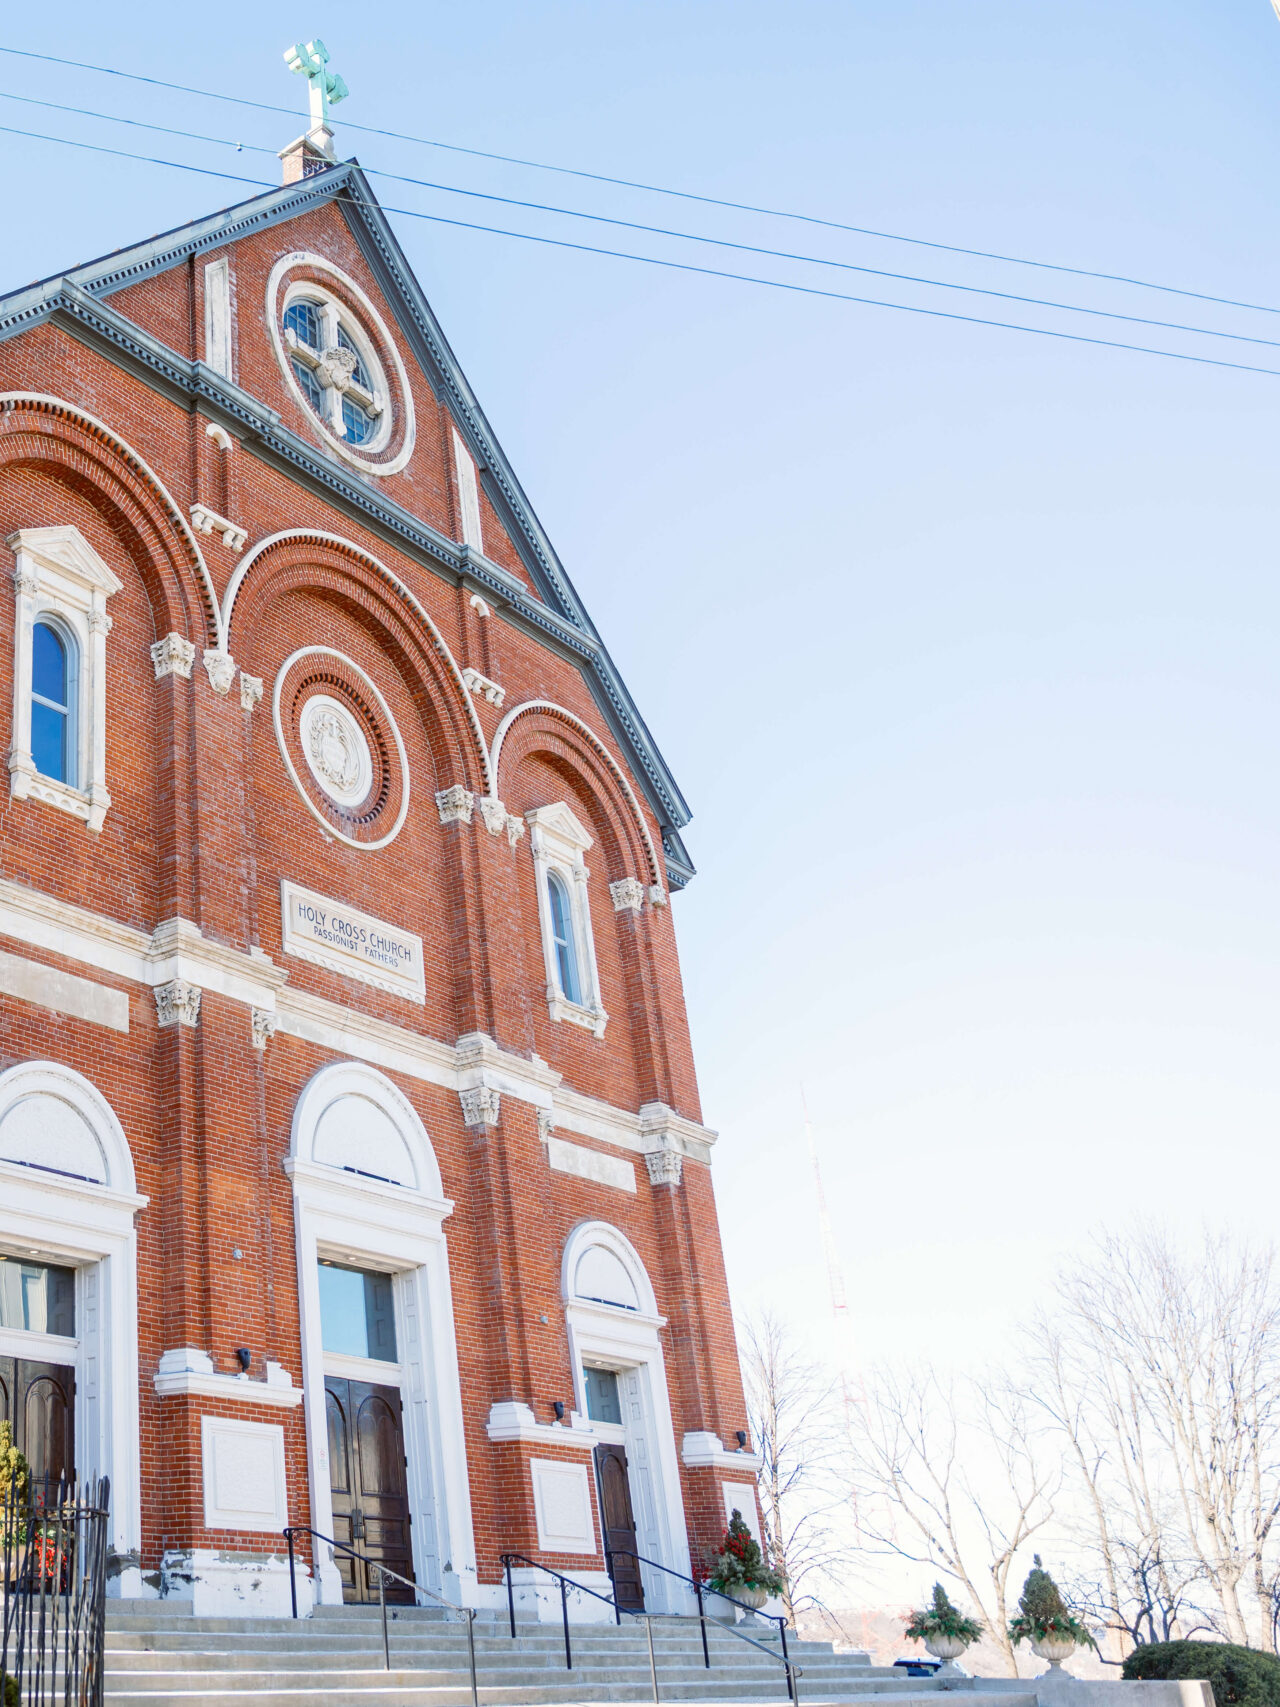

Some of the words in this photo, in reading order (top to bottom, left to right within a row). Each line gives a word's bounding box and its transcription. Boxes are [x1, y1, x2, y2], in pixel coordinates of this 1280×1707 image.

[298, 903, 326, 927] HOLY
[331, 917, 366, 943] CROSS
[369, 933, 412, 962] CHURCH
[313, 926, 358, 952] PASSIONIST
[364, 946, 399, 968] FATHERS
